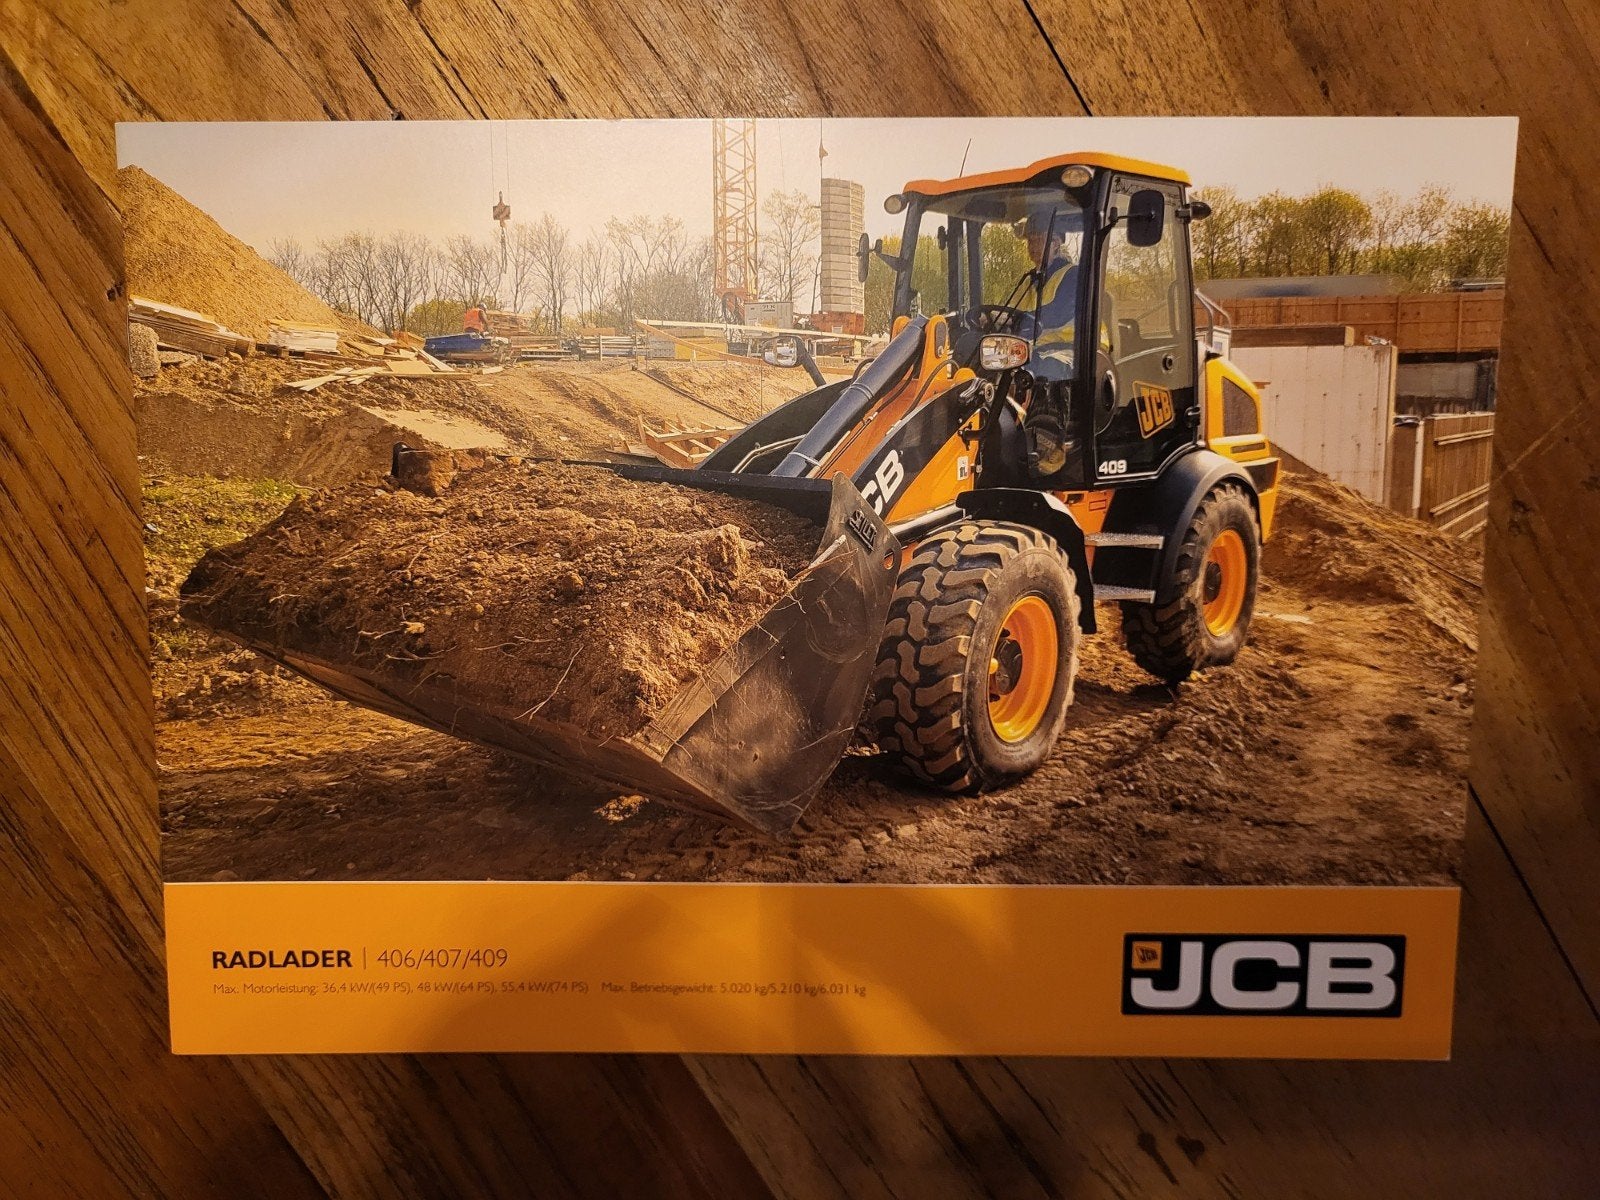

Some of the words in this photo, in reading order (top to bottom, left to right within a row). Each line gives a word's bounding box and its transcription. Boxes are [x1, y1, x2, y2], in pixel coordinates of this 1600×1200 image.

[1140, 386, 1173, 433] JCB
[1098, 459, 1128, 475] 409
[212, 949, 353, 969] RADLADER
[377, 948, 509, 970] 406/407/409
[1130, 940, 1397, 1011] JCB
[213, 983, 239, 994] Max.
[243, 982, 320, 997] Motorleistung:
[322, 982, 347, 995] 36,4
[350, 981, 390, 995] kW/(49
[393, 981, 414, 995] PS),
[417, 981, 431, 993] 48
[434, 981, 474, 994] kW/(64
[528, 981, 568, 994] kW/(74
[571, 981, 590, 995] PS)
[600, 982, 627, 993] Max.
[630, 981, 716, 996] Betriebsgewicht:
[720, 982, 751, 994] 5.020
[754, 982, 801, 996] kg/5.210
[804, 982, 850, 997] kg/6.031
[854, 983, 867, 997] kg
